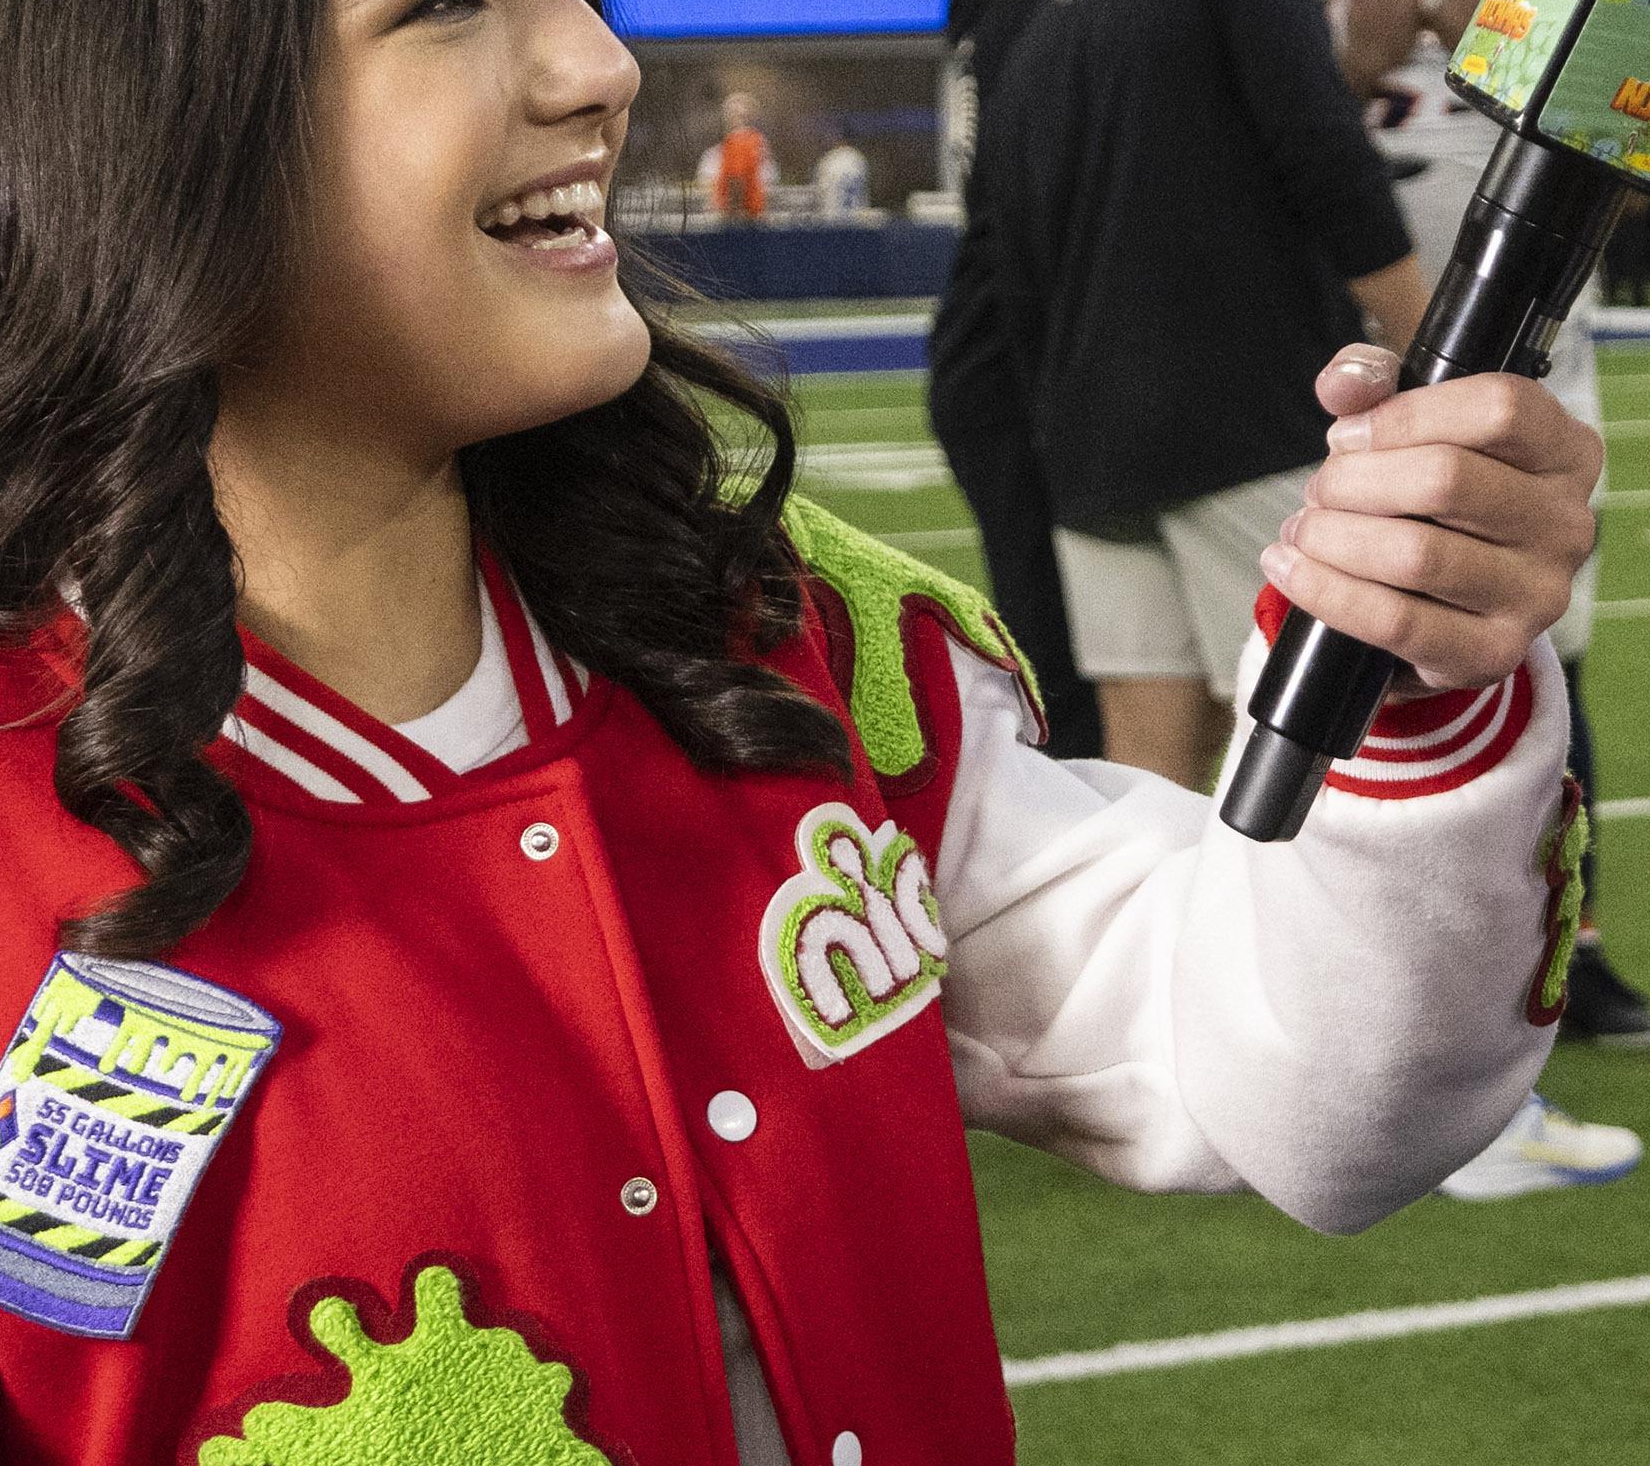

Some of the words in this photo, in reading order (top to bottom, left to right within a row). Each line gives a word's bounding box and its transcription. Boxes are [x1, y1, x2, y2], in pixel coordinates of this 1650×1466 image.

[36, 1097, 71, 1126] 55
[69, 1111, 186, 1164] GALLONS
[17, 1121, 173, 1208] SLIME
[54, 1183, 156, 1231] POUNDS
